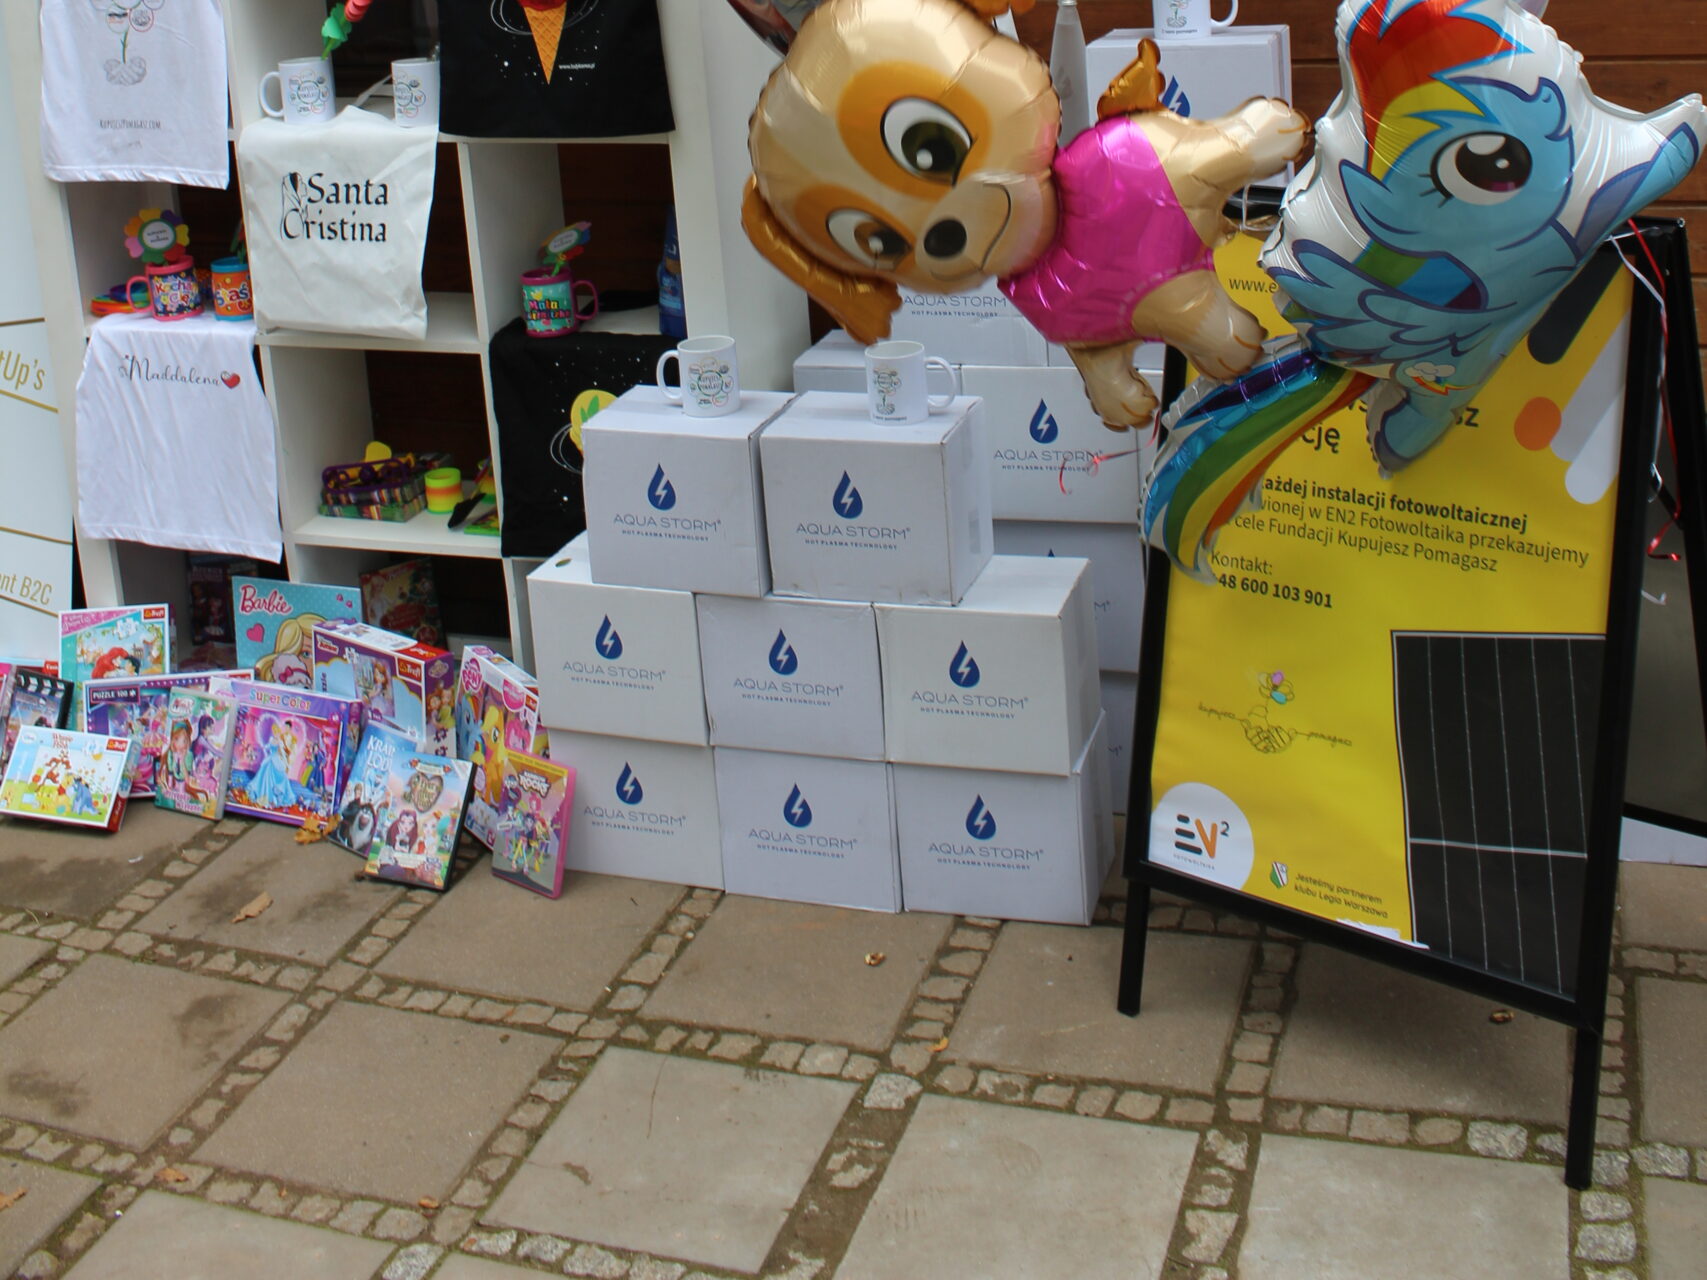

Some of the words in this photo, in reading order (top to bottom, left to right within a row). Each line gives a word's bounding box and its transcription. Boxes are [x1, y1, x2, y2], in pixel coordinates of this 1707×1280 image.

[307, 172, 388, 205] Santa
[284, 208, 387, 242] Cristina
[904, 295, 946, 306] AQUA
[950, 296, 1007, 307] STORM
[994, 449, 1038, 461] AQUA
[1262, 475, 1308, 499] ażdej
[1311, 481, 1386, 511] instalacji
[1389, 493, 1528, 535] fotowoltaicznej
[614, 514, 657, 527] AQUA
[660, 517, 717, 532] STORM
[796, 523, 843, 536] AQUA
[846, 526, 906, 539] STORM
[1234, 514, 1265, 531] cele
[1269, 518, 1334, 547] Fundacji
[1338, 529, 1410, 557] Kupujesz
[1414, 542, 1498, 572] Pomagasz
[1309, 507, 1322, 519] w
[1326, 506, 1356, 526] EN2
[1360, 512, 1465, 544] Fotowoltaika
[1469, 531, 1590, 569] przekazujemy
[1211, 549, 1273, 576] Kontakt:
[0, 573, 16, 593] nt
[20, 575, 53, 605] B2C
[240, 584, 293, 615] Barbie
[1215, 573, 1236, 589] 48
[1241, 577, 1268, 596] 600
[1273, 583, 1300, 601] 103
[1304, 589, 1332, 608] 901
[563, 661, 605, 674] AQUA
[608, 666, 662, 681] STORM
[93, 690, 115, 699] PUZZLE
[734, 678, 778, 691] AQUA
[782, 682, 840, 696] STORM
[912, 691, 959, 704] AQUA
[962, 695, 1024, 709] STORM
[584, 806, 625, 819] AQUA
[628, 811, 683, 827] STORM
[749, 828, 793, 842] AQUA
[795, 834, 854, 850] STORM
[928, 842, 976, 856] AQUA
[978, 847, 1040, 861] STORM
[1294, 884, 1317, 897] klubu
[1319, 891, 1342, 905] Legia
[1344, 898, 1389, 919] Warszawa
[1336, 886, 1382, 904] partnerem
